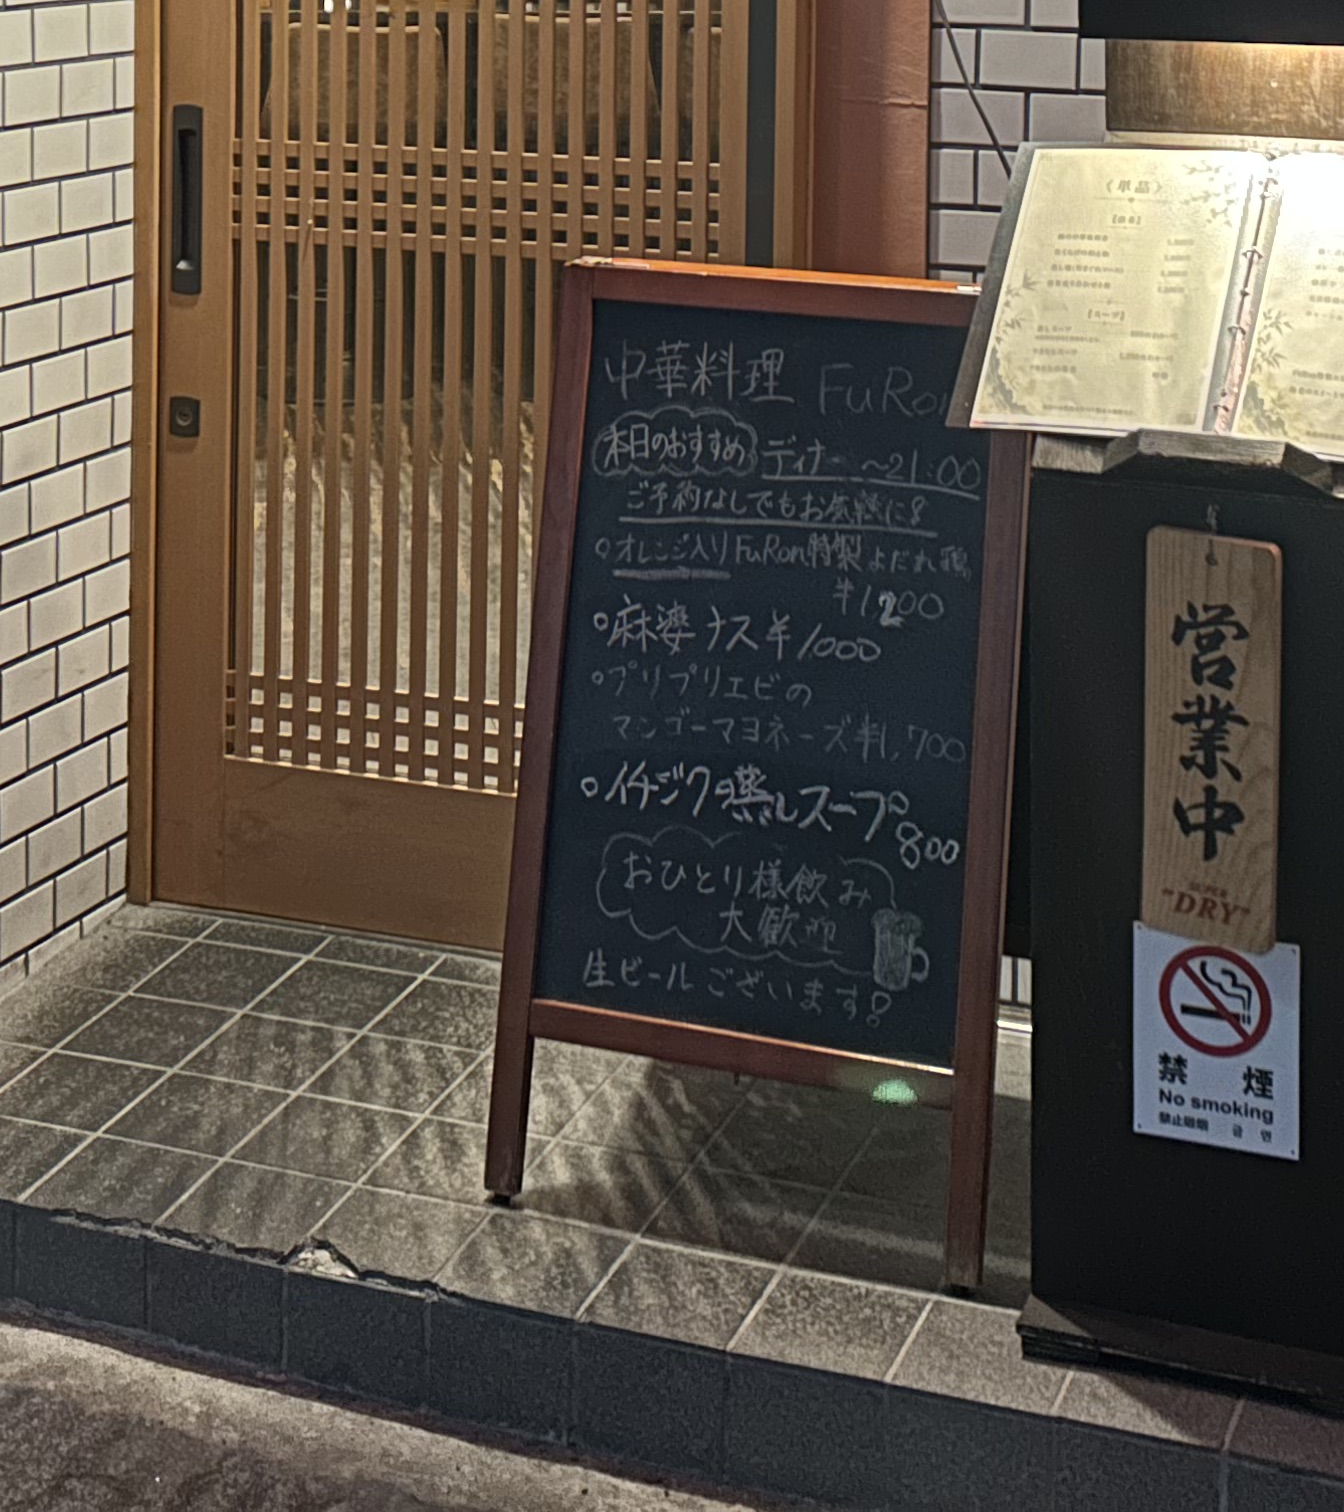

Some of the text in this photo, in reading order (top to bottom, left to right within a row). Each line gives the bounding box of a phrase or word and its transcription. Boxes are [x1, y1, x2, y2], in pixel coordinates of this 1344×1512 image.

[605, 339, 794, 403] 中華料理
[603, 423, 746, 469] 本日のおすすめ
[1170, 600, 1251, 863] 営業中
[895, 821, 961, 870] 800
[1158, 1088, 1275, 1126] No smoking
